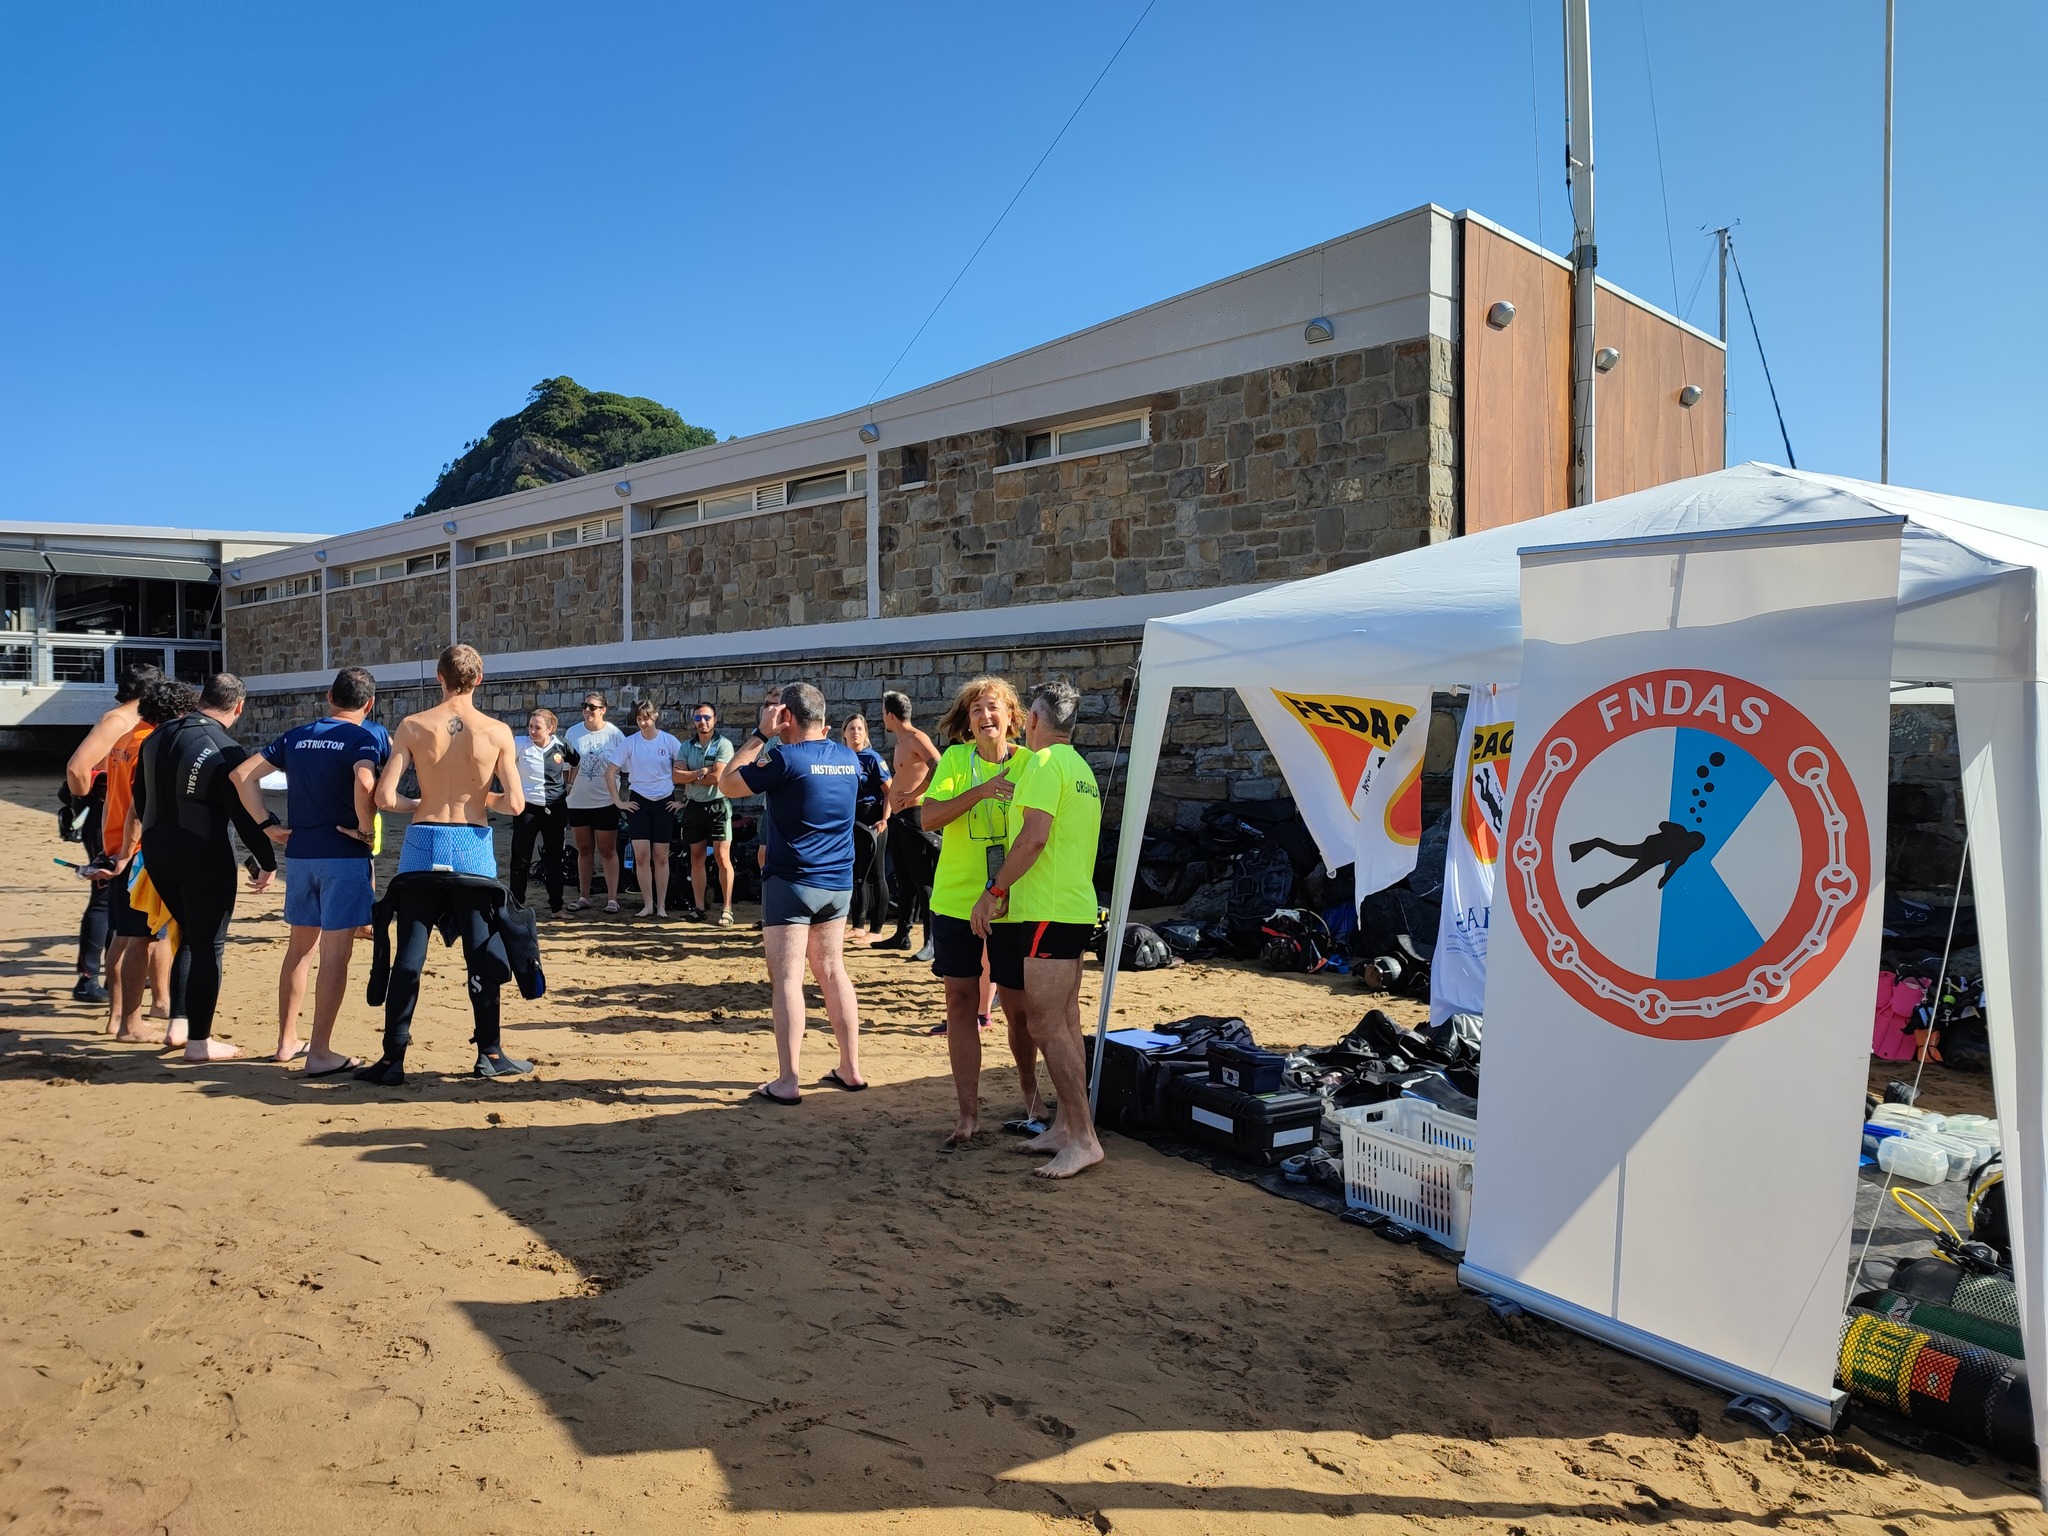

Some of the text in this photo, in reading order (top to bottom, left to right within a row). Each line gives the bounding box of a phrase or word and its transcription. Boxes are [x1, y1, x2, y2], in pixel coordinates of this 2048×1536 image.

[1597, 679, 1770, 735] FNDAS
[294, 739, 345, 751] INSTRUCTOR
[186, 747, 213, 795] DIVE SAIL
[811, 764, 856, 776] INSTRUCTOR
